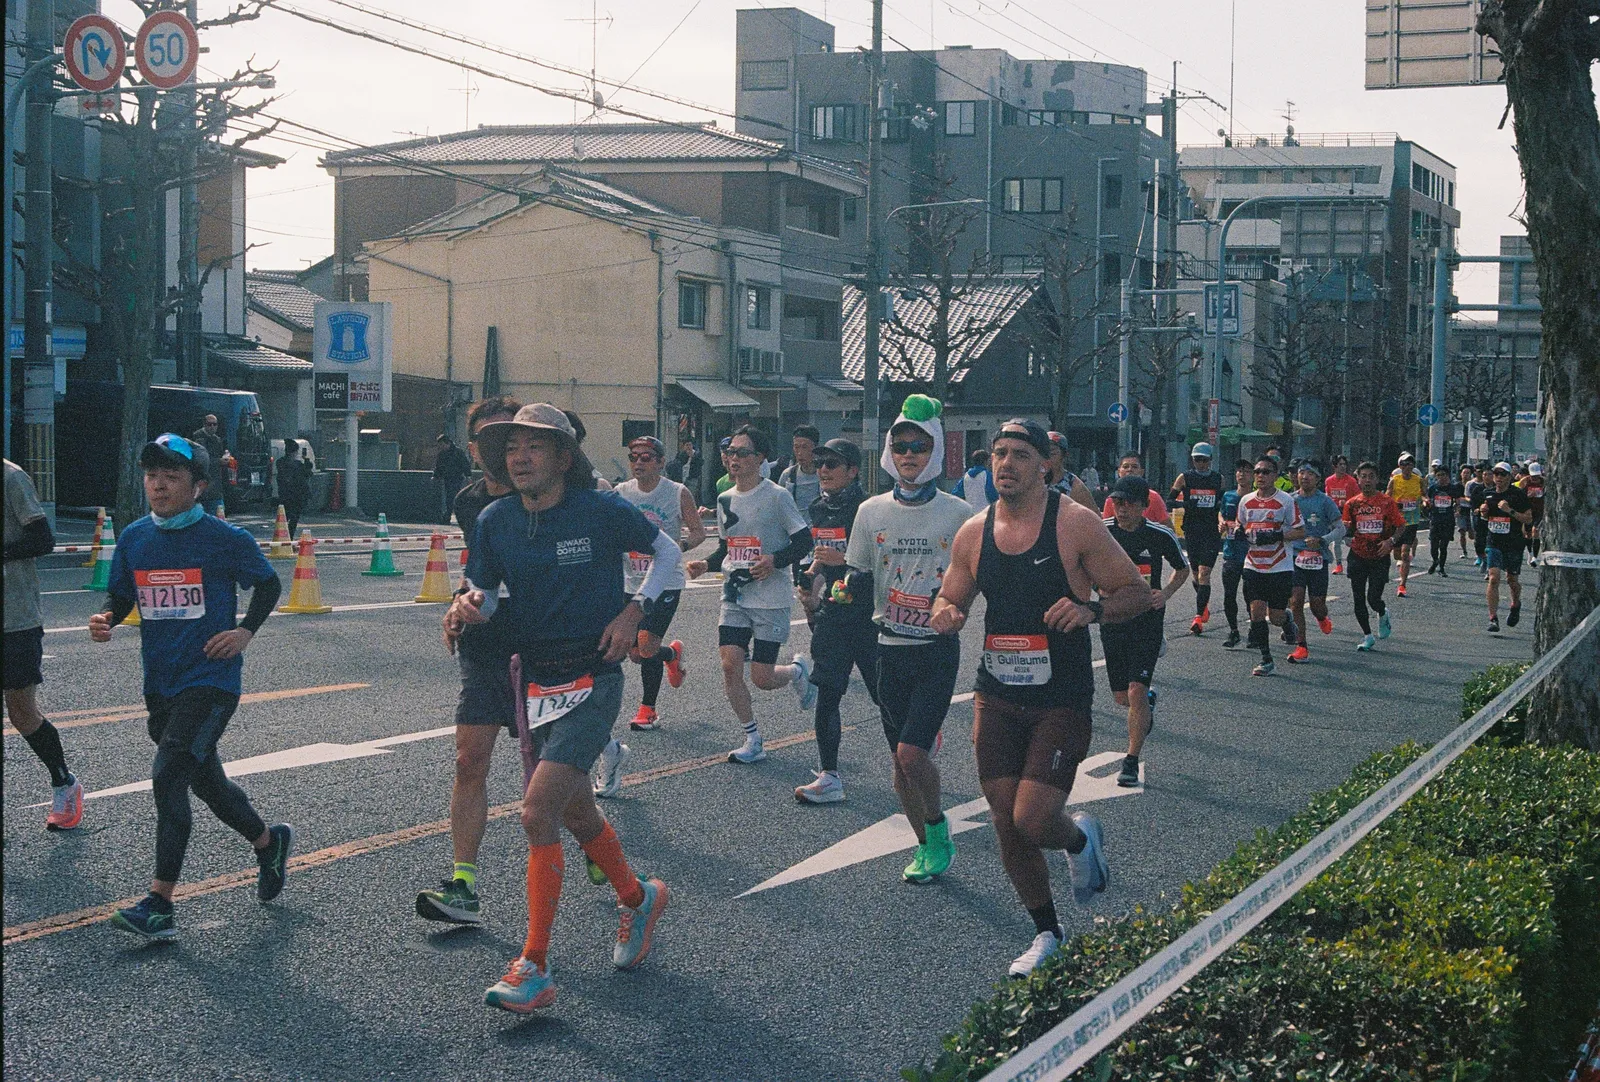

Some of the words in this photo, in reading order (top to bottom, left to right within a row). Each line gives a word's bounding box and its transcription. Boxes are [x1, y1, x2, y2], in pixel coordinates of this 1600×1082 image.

[150, 33, 183, 66] 50
[330, 315, 367, 325] LAWSON
[331, 350, 366, 359] STATION
[318, 382, 345, 391] MACHI
[556, 537, 591, 548] SUWAKO
[897, 538, 928, 546] KYOTO
[891, 547, 933, 556] marathon
[638, 559, 653, 571] 12
[152, 585, 201, 607] 12130
[997, 654, 1048, 665] Guillaume
